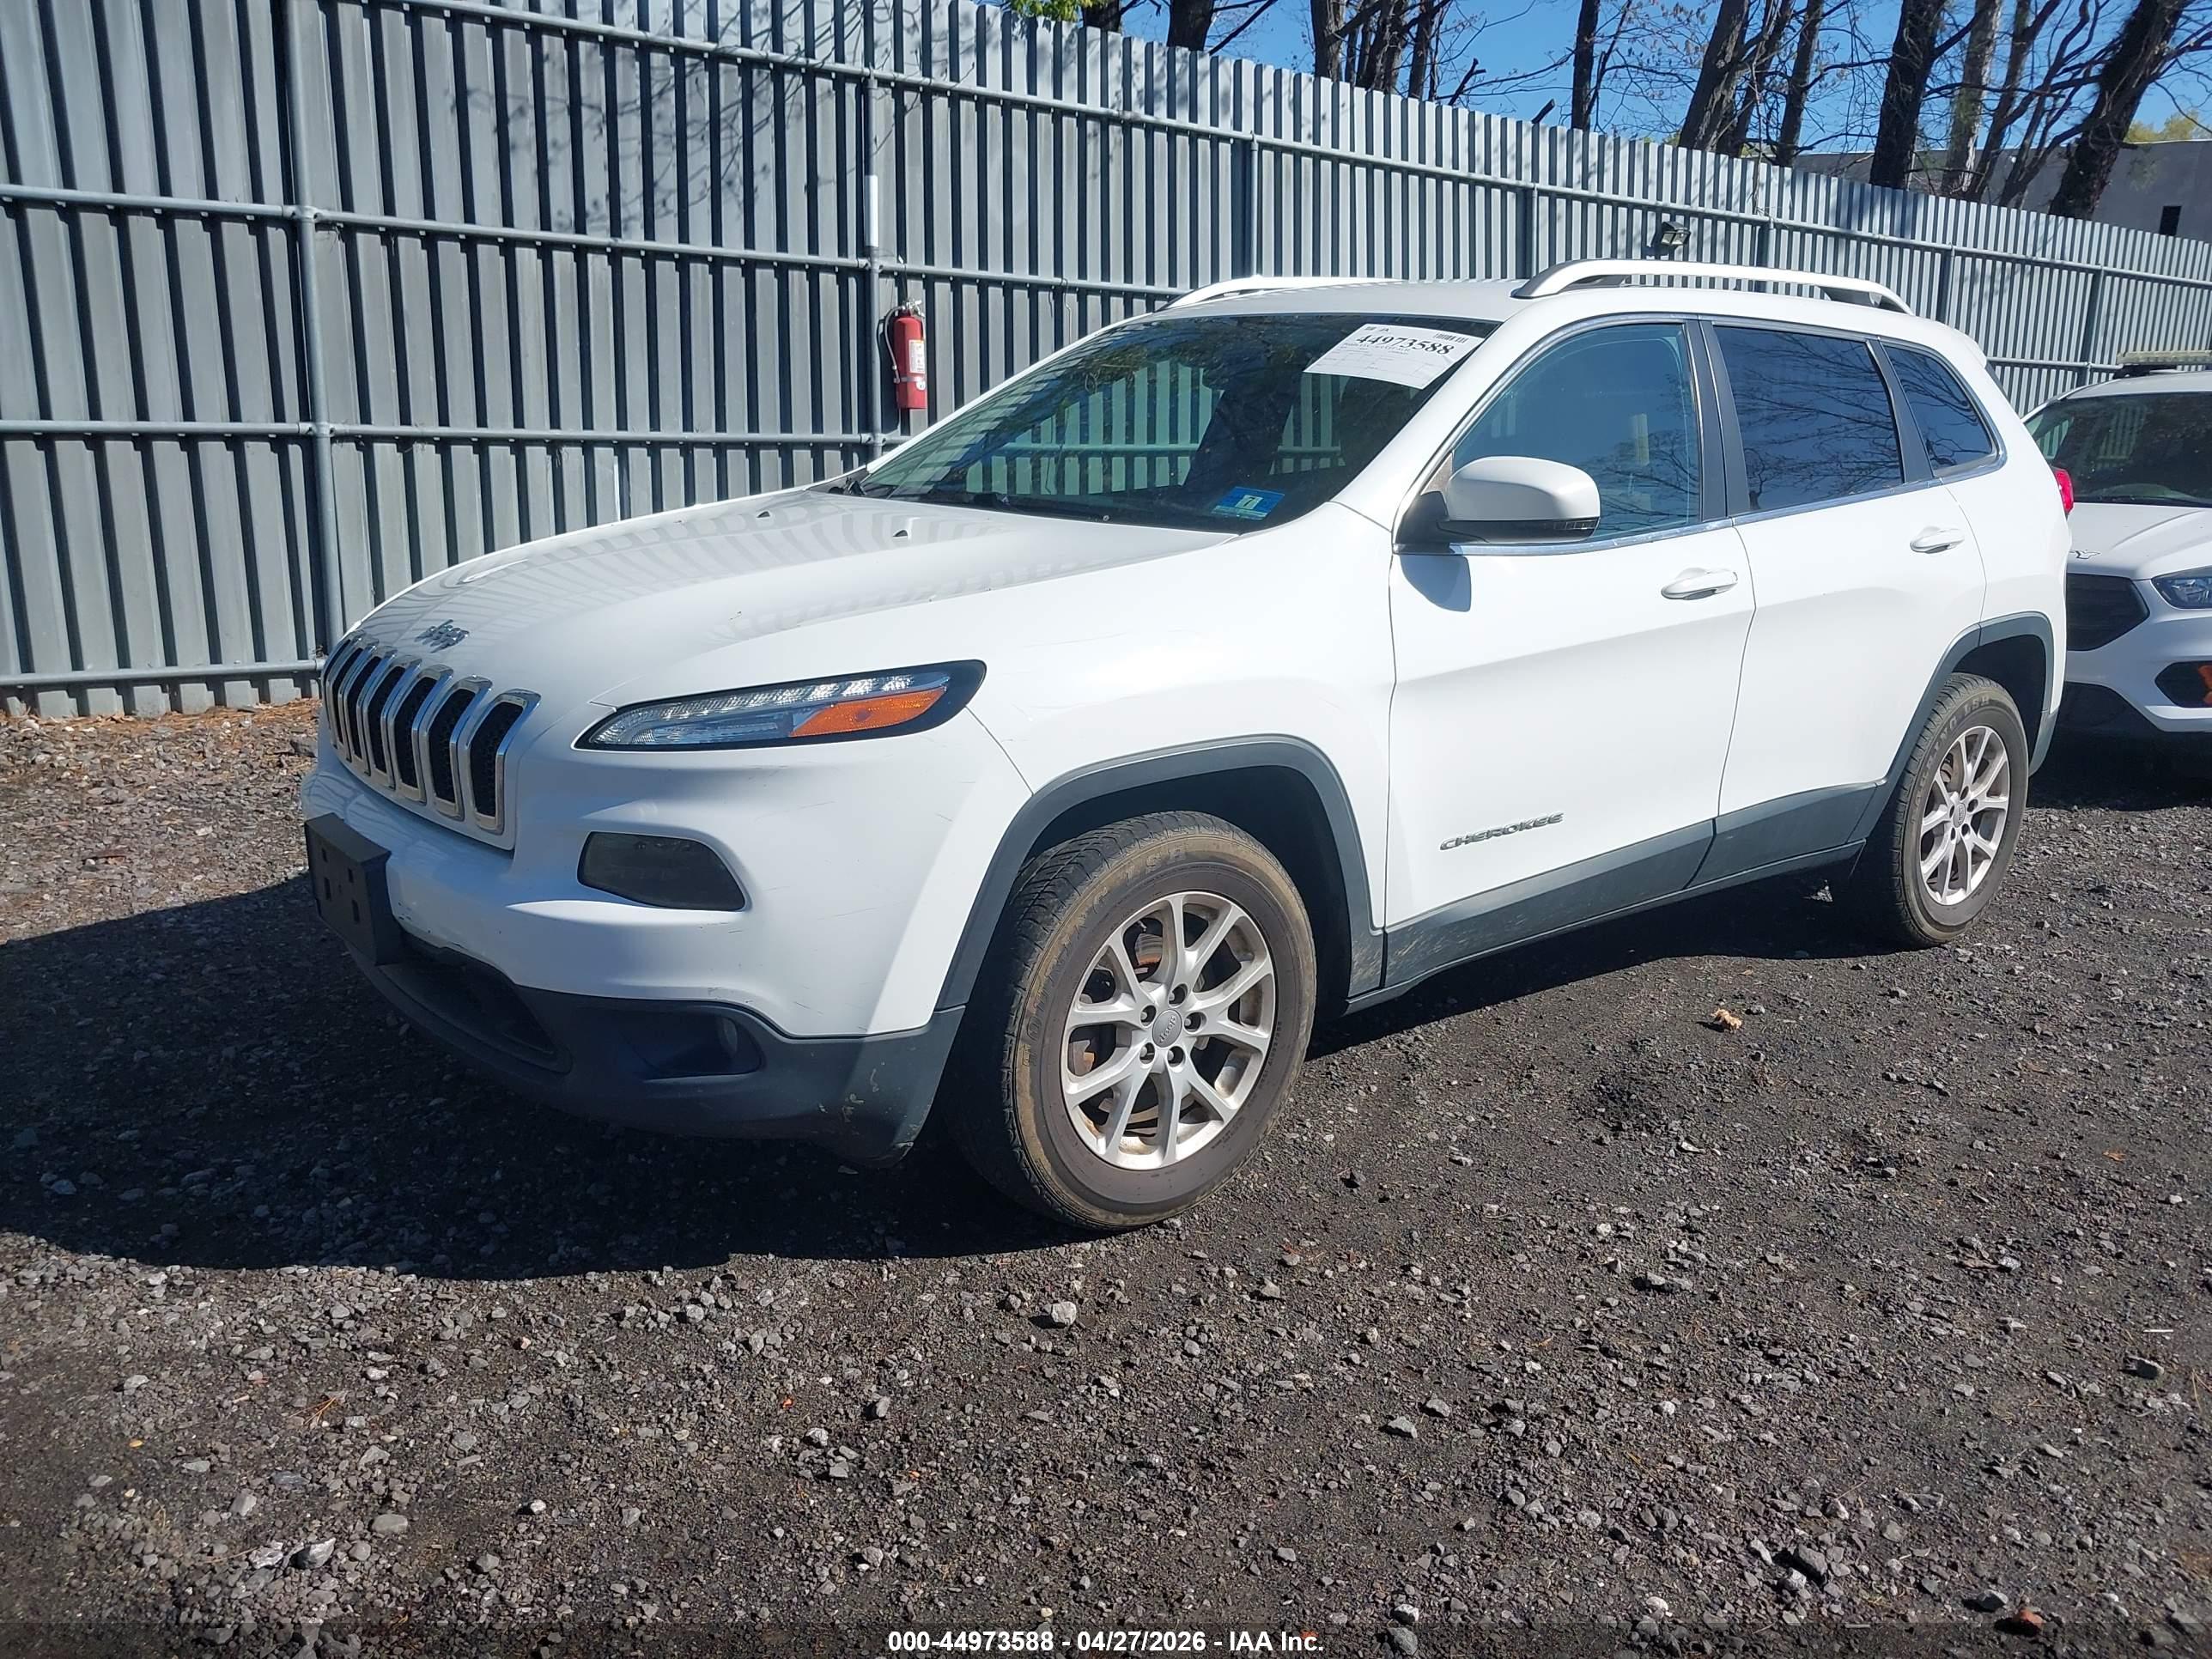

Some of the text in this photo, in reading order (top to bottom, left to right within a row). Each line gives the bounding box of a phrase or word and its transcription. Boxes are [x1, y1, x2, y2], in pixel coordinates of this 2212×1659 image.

[1357, 334, 1455, 355] 44973588
[1243, 495, 1255, 507] 7
[414, 619, 470, 653] Jeep
[1439, 812, 1564, 850] CHEROKEE
[1158, 1015, 1176, 1044] Jeep
